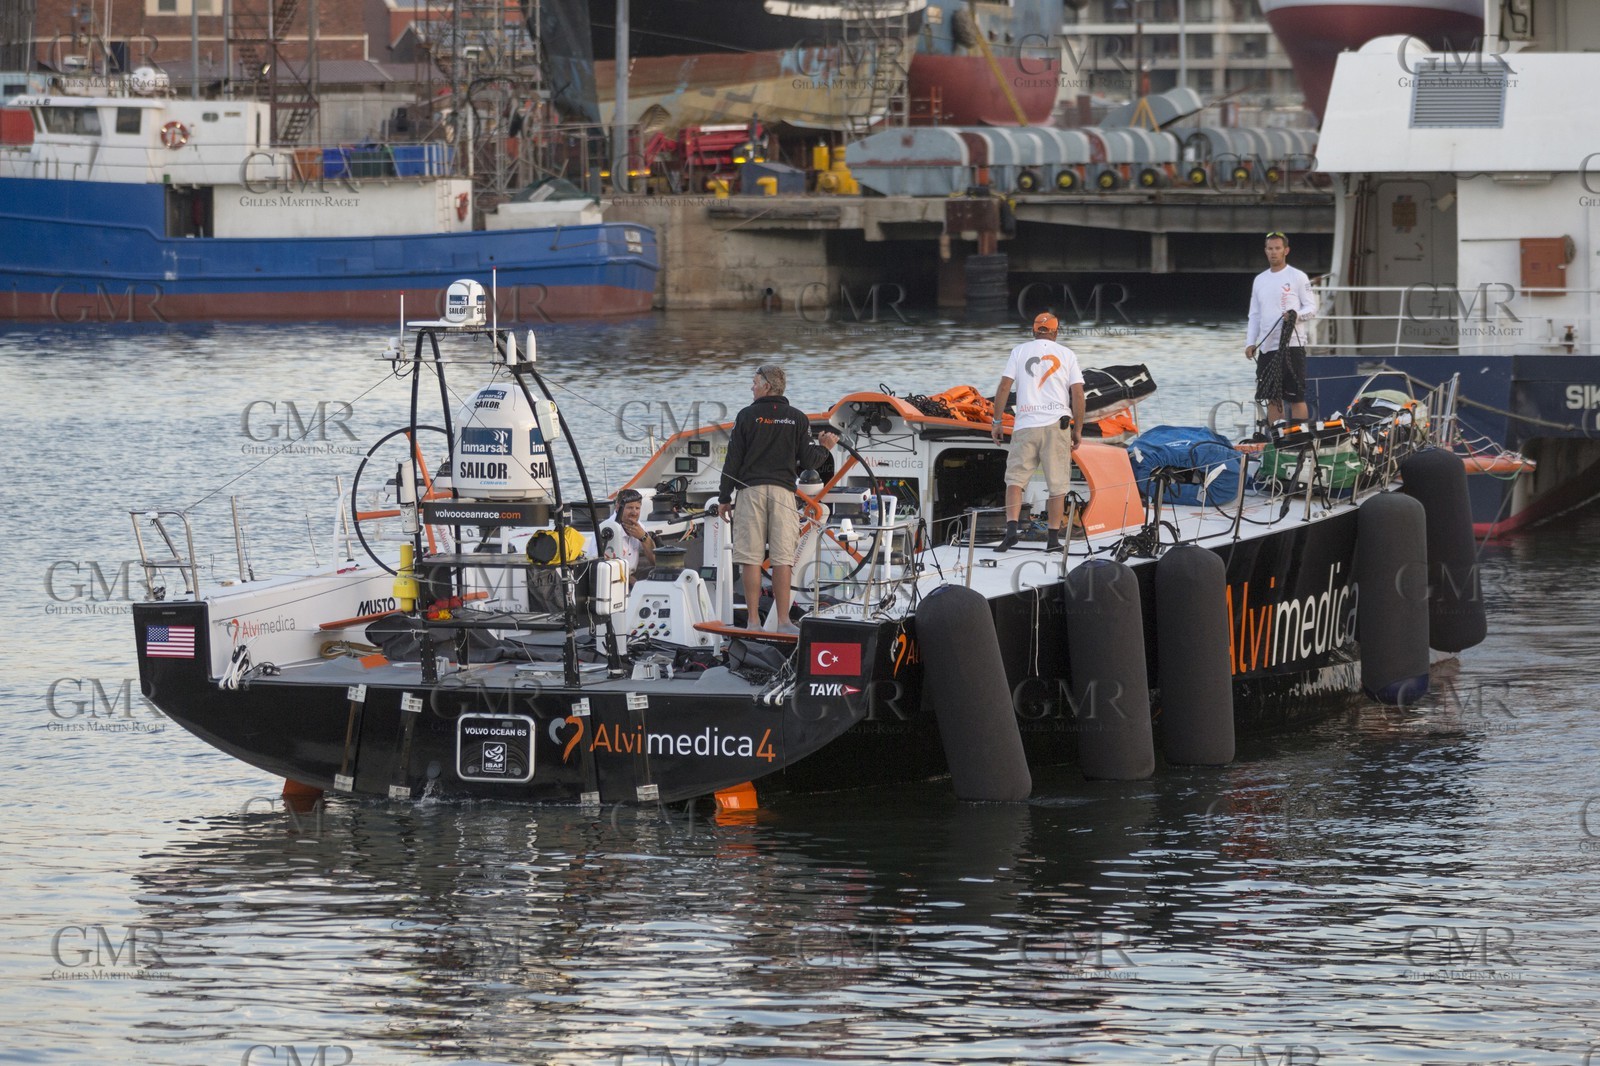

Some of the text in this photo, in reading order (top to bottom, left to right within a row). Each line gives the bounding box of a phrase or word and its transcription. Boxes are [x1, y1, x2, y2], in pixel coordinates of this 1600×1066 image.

[474, 400, 500, 409] SAILOR
[1019, 402, 1065, 413] Alvimedica
[462, 441, 509, 453] inmarsat
[864, 456, 924, 469] Alvimedica
[460, 461, 508, 479] SAILOR
[435, 509, 521, 520] volvooceanrace.com
[357, 597, 397, 616] MUSTO
[242, 616, 296, 639] Alvimedica
[809, 683, 843, 696] TAYK
[465, 727, 489, 735] VOLVO
[490, 728, 516, 736] OCEAN
